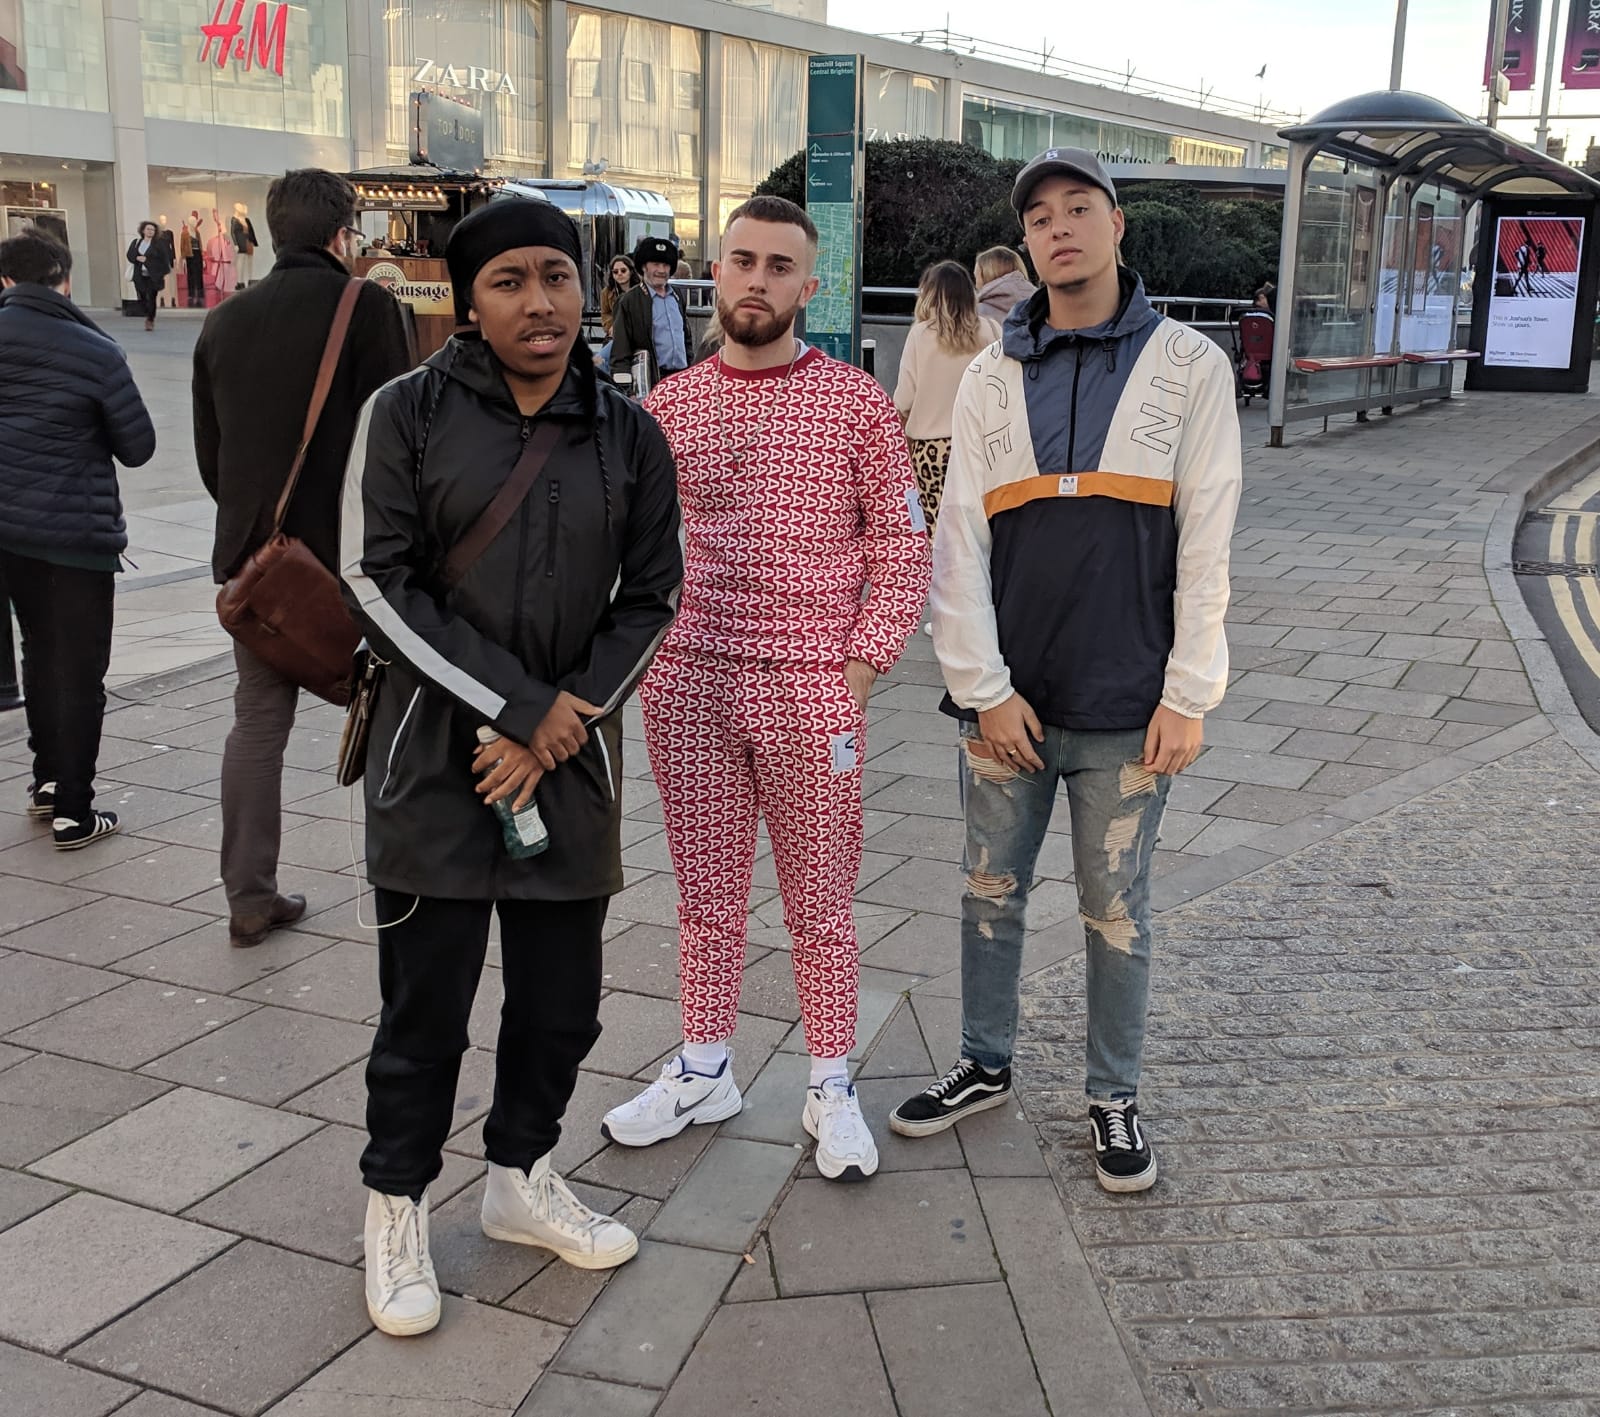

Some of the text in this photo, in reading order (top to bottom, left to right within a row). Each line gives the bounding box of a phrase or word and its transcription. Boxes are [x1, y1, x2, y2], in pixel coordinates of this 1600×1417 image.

[199, 0, 288, 77] H&M
[414, 57, 519, 96] ZARA
[830, 68, 854, 76] Brighton
[866, 127, 910, 143] ZAR
[386, 283, 450, 303] Sausage
